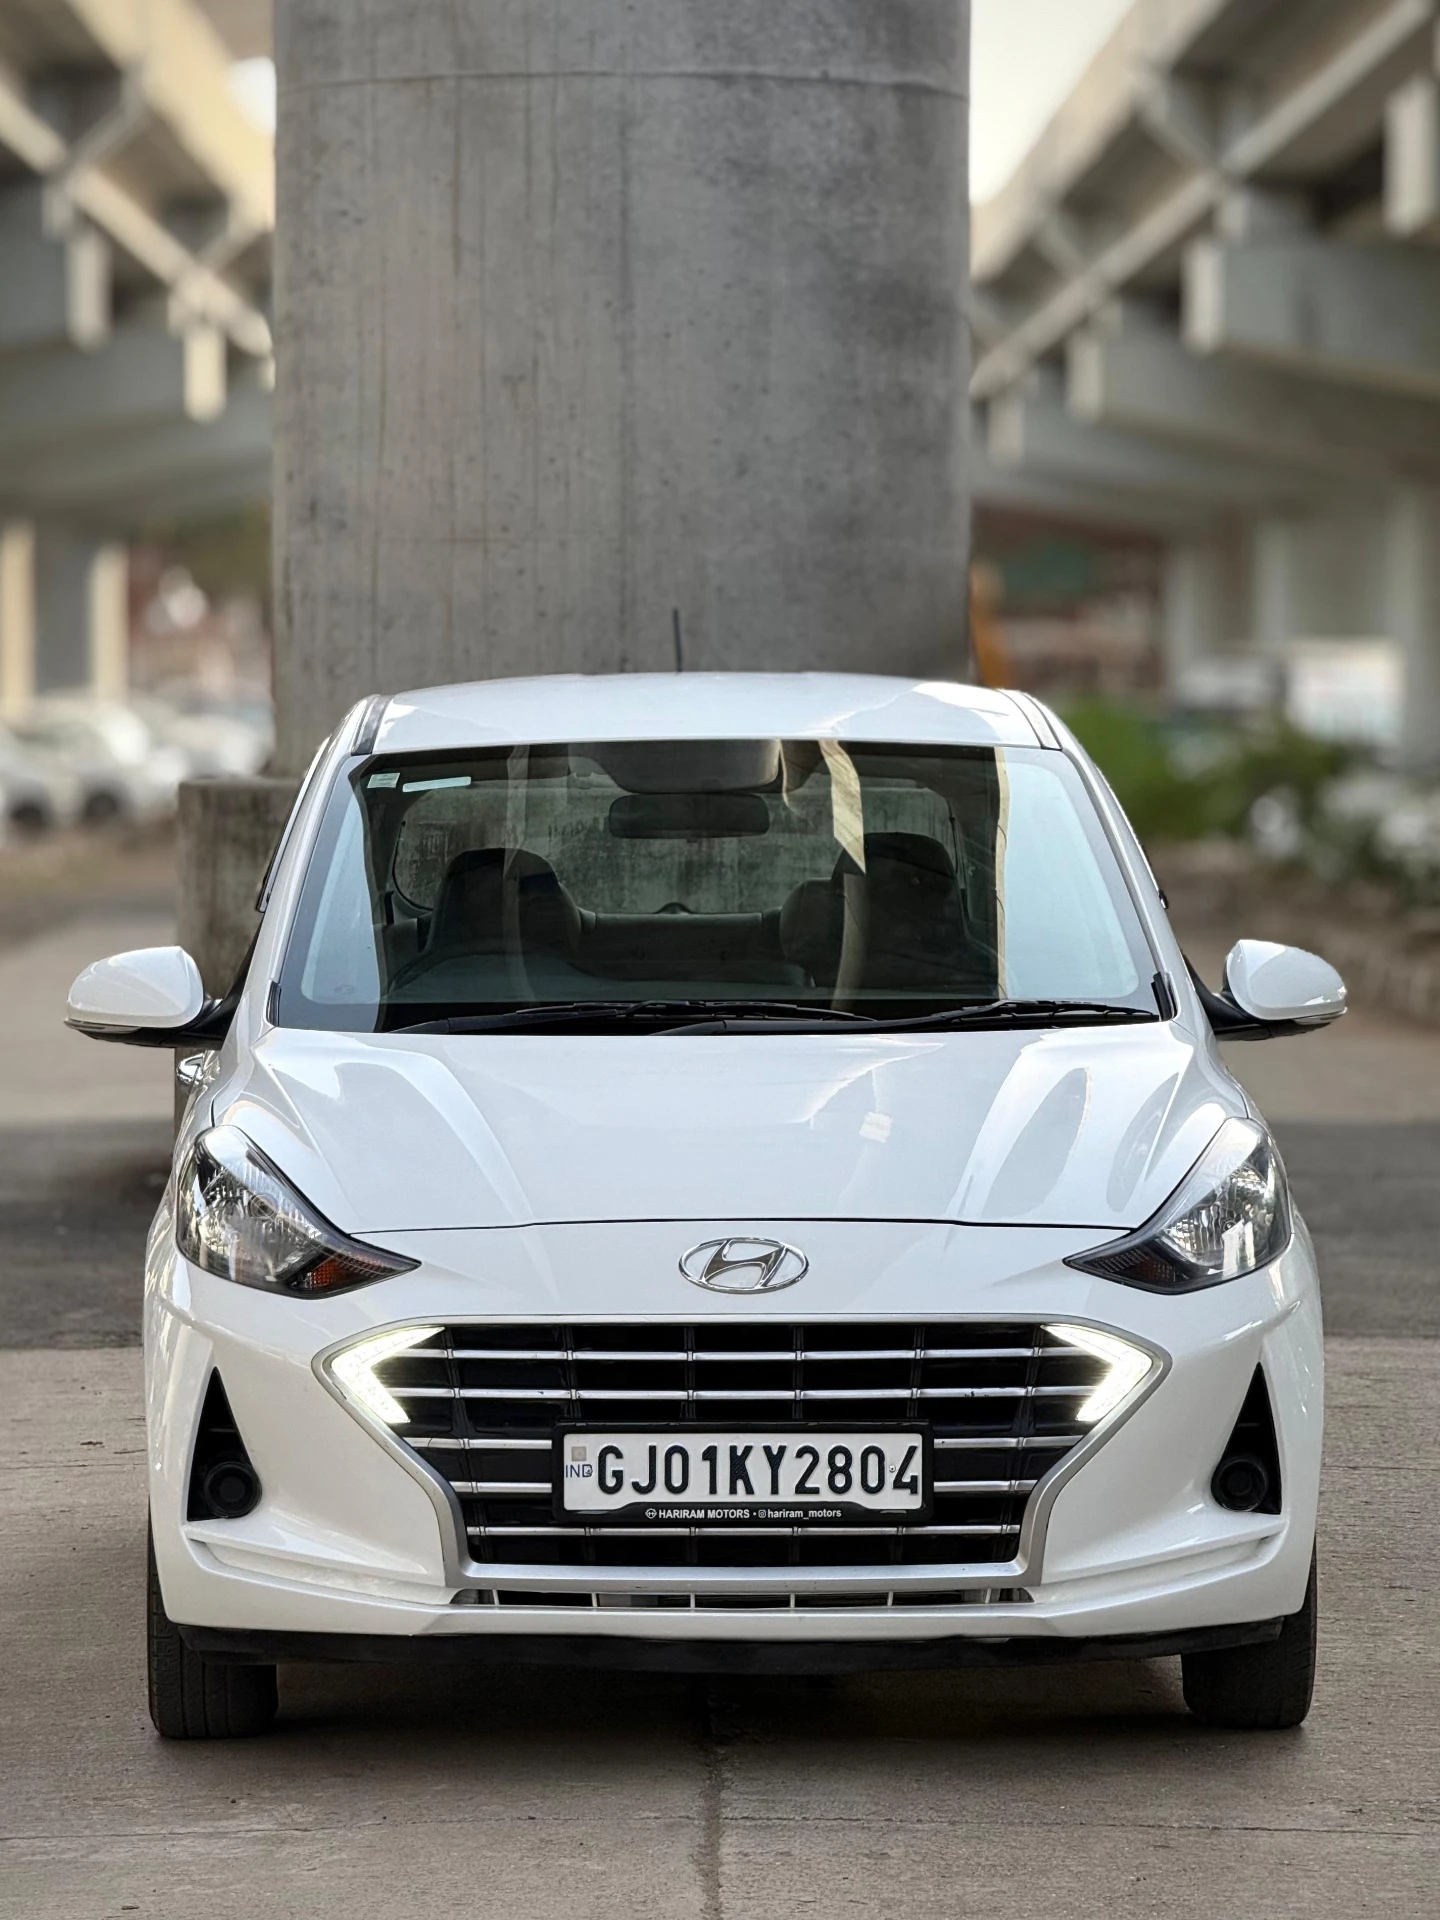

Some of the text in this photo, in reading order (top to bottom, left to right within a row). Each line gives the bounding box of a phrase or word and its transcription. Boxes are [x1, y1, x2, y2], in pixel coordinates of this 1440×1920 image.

[565, 1464, 593, 1478] IND
[597, 1444, 919, 1495] GJ01KY2804
[658, 1509, 705, 1519] HARIRAM
[707, 1509, 750, 1519] MOTORS
